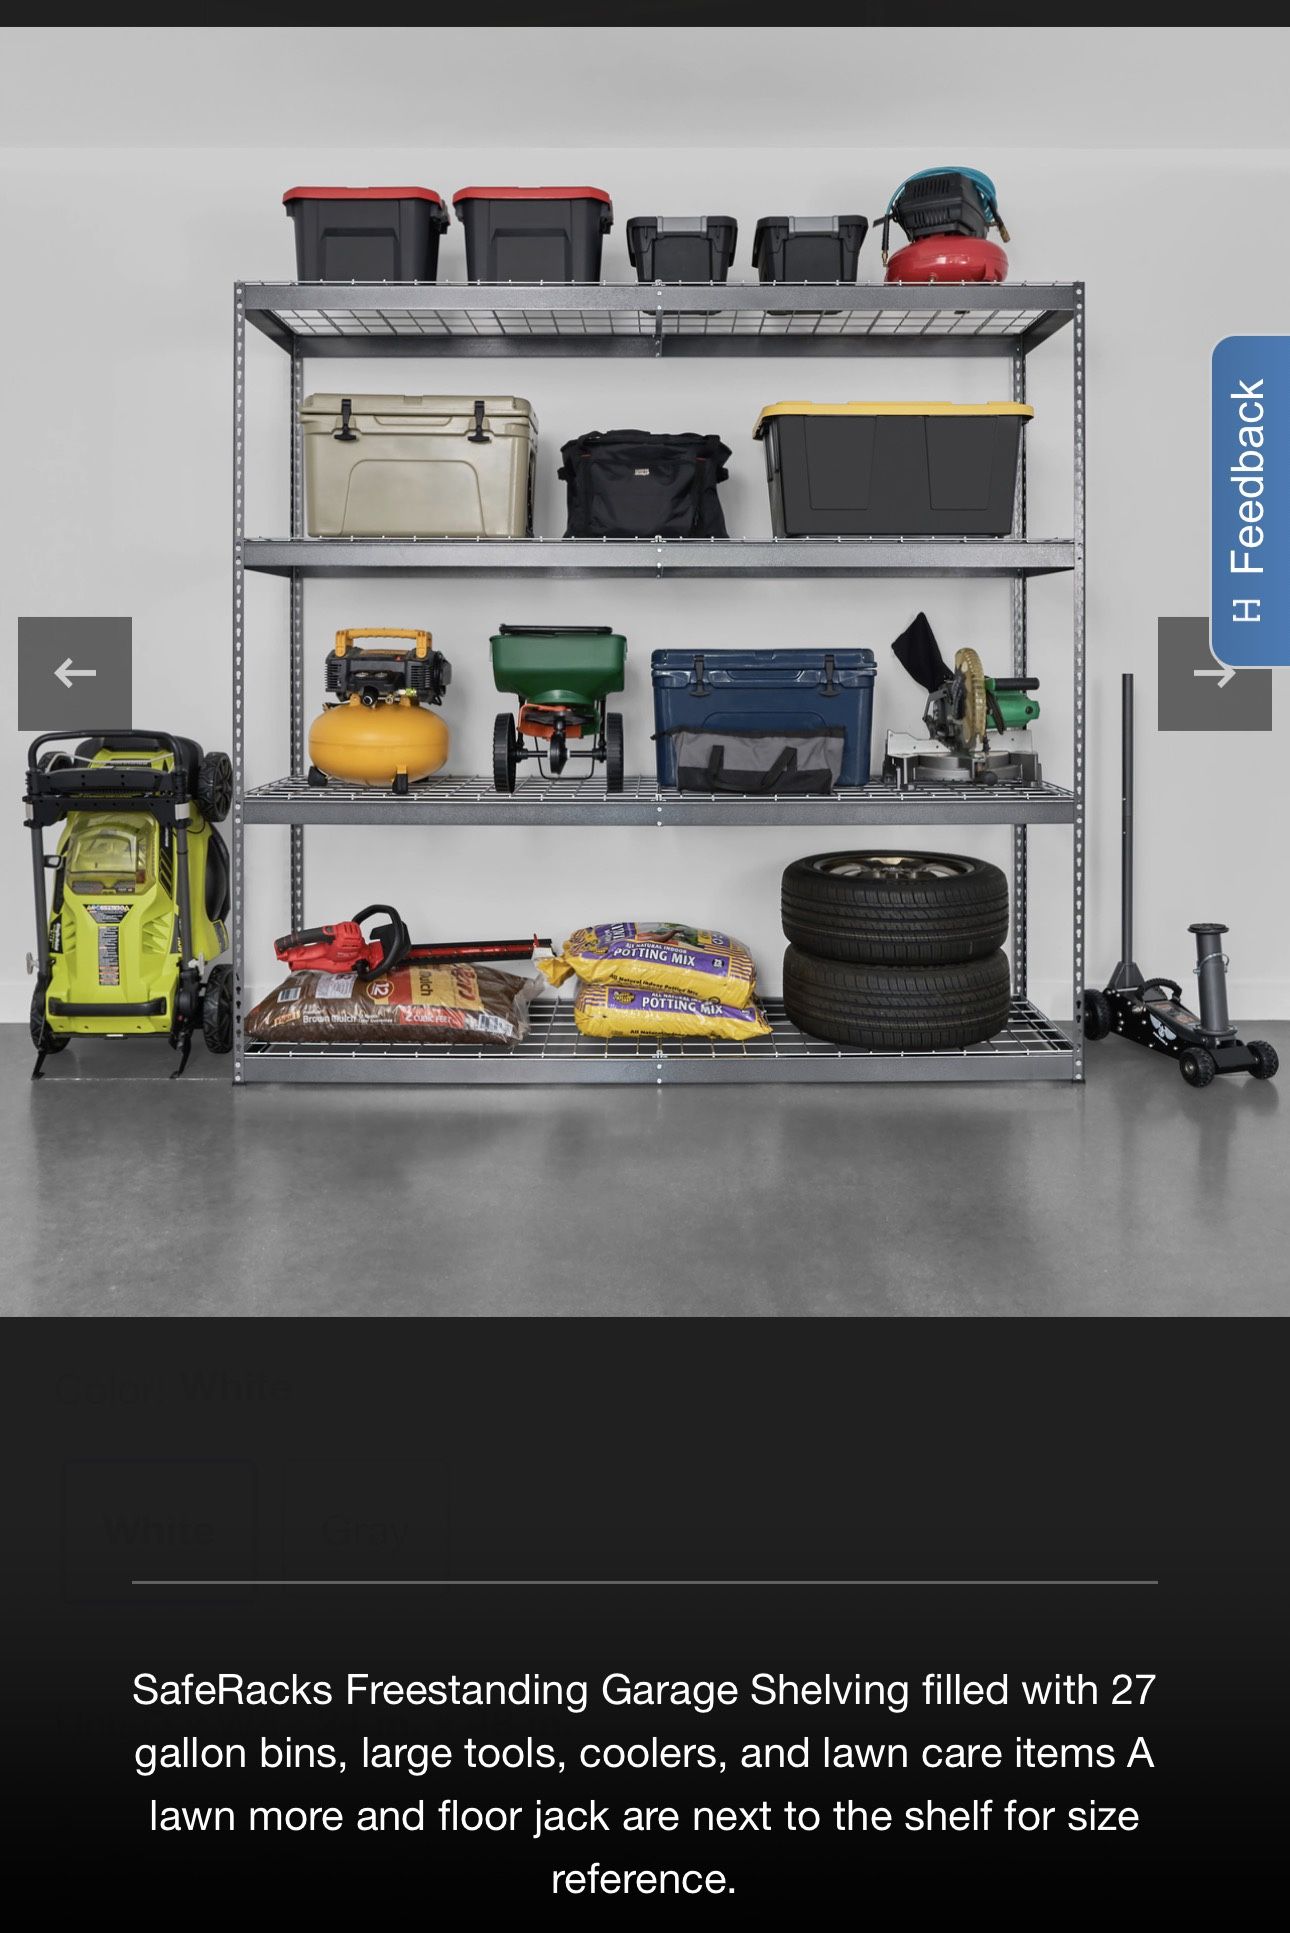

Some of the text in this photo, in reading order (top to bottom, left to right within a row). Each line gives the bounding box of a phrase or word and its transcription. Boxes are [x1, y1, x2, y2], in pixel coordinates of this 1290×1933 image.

[663, 946, 687, 954] INDOOR
[613, 947, 668, 961] POTTING
[671, 953, 696, 967] MIX
[374, 983, 390, 996] 12
[642, 997, 724, 1015] POTTING MIX
[303, 1015, 330, 1024] Brown
